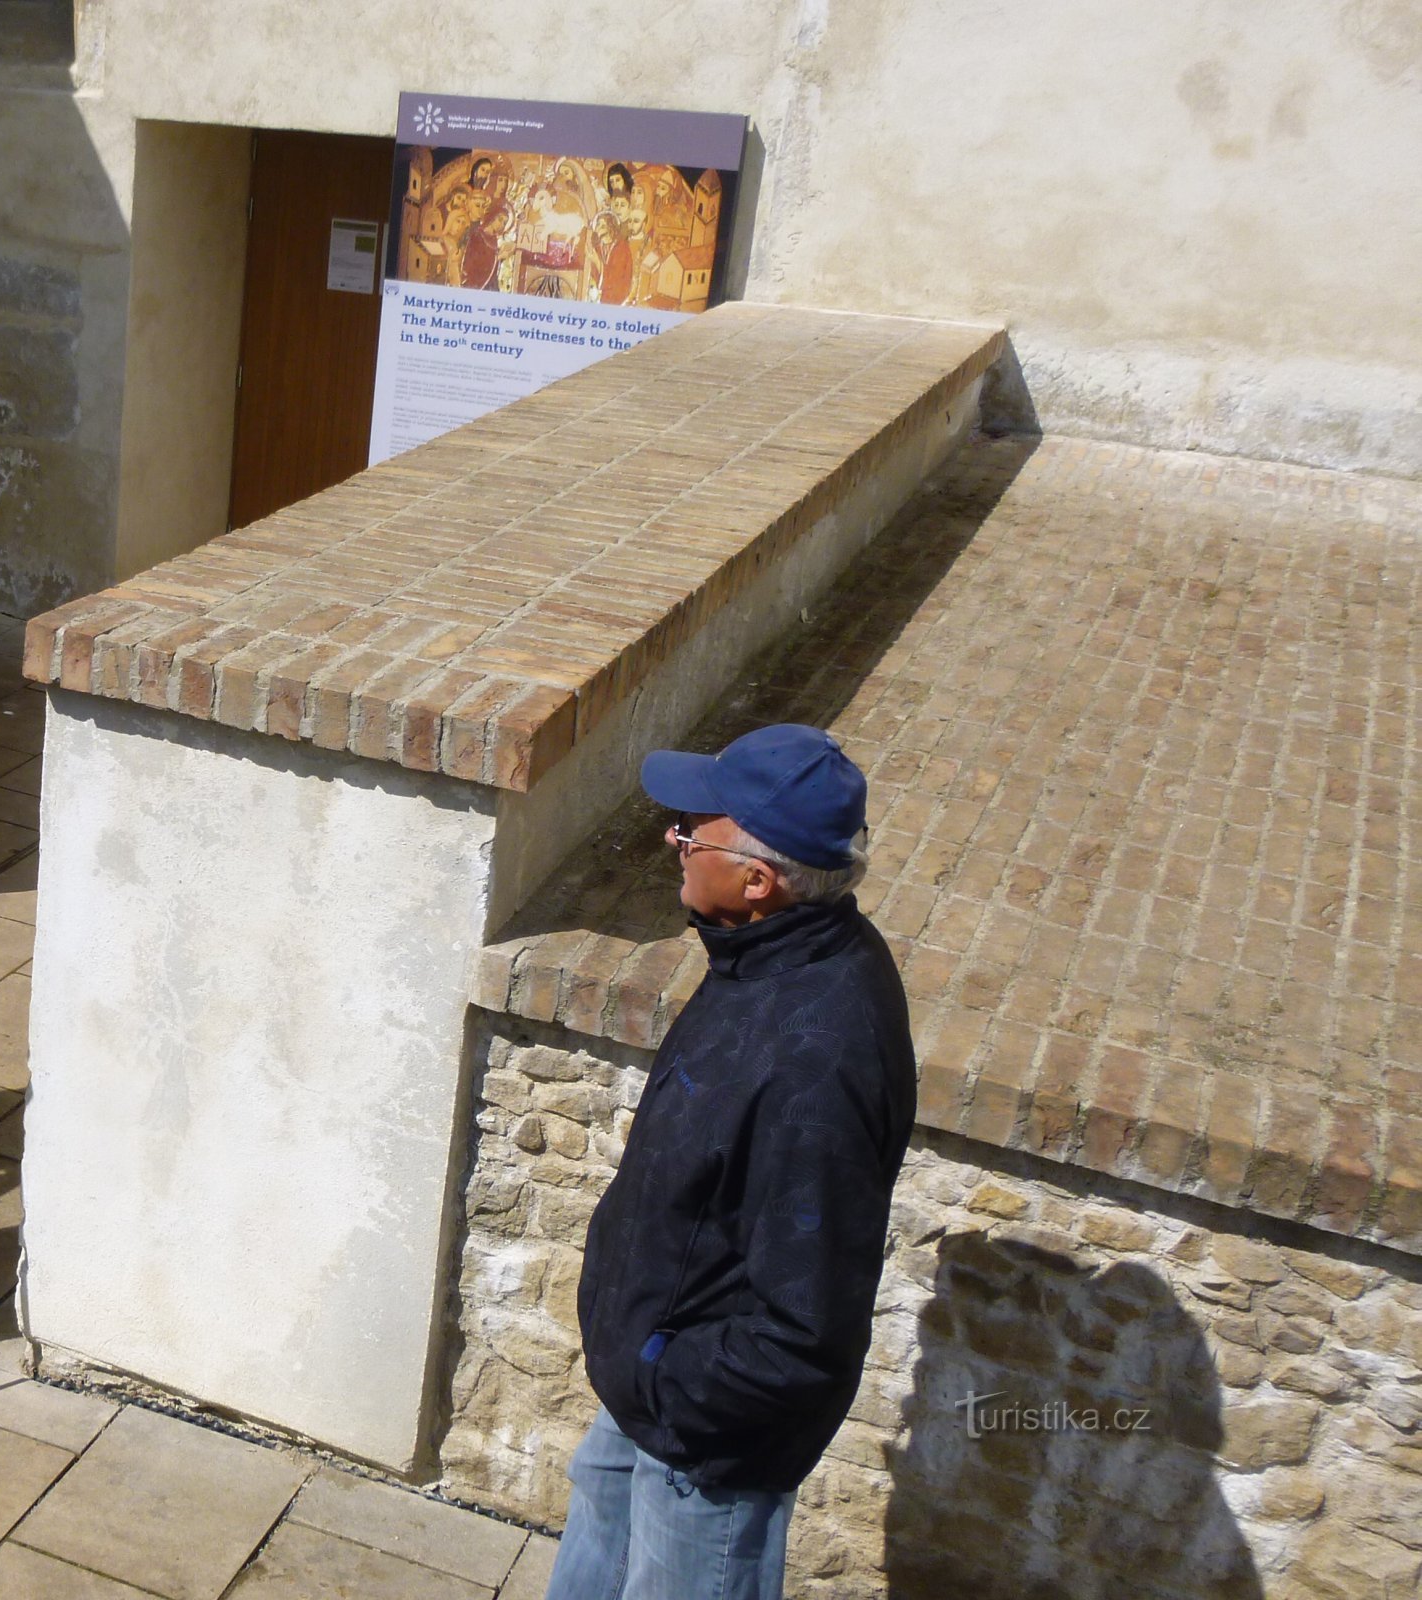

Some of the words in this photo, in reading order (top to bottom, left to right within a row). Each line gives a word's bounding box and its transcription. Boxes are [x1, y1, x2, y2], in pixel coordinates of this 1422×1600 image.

[401, 312, 426, 326] The
[430, 316, 500, 336] Martyrion
[518, 327, 585, 346] witnesses
[590, 335, 604, 348] to
[608, 336, 632, 351] the
[402, 294, 473, 314] Martyrion
[490, 305, 554, 324] svědkové
[558, 312, 587, 329] víry
[591, 319, 610, 330] 20.
[615, 319, 661, 336] století
[400, 330, 414, 343] in
[418, 332, 439, 346] the
[470, 341, 524, 359] century
